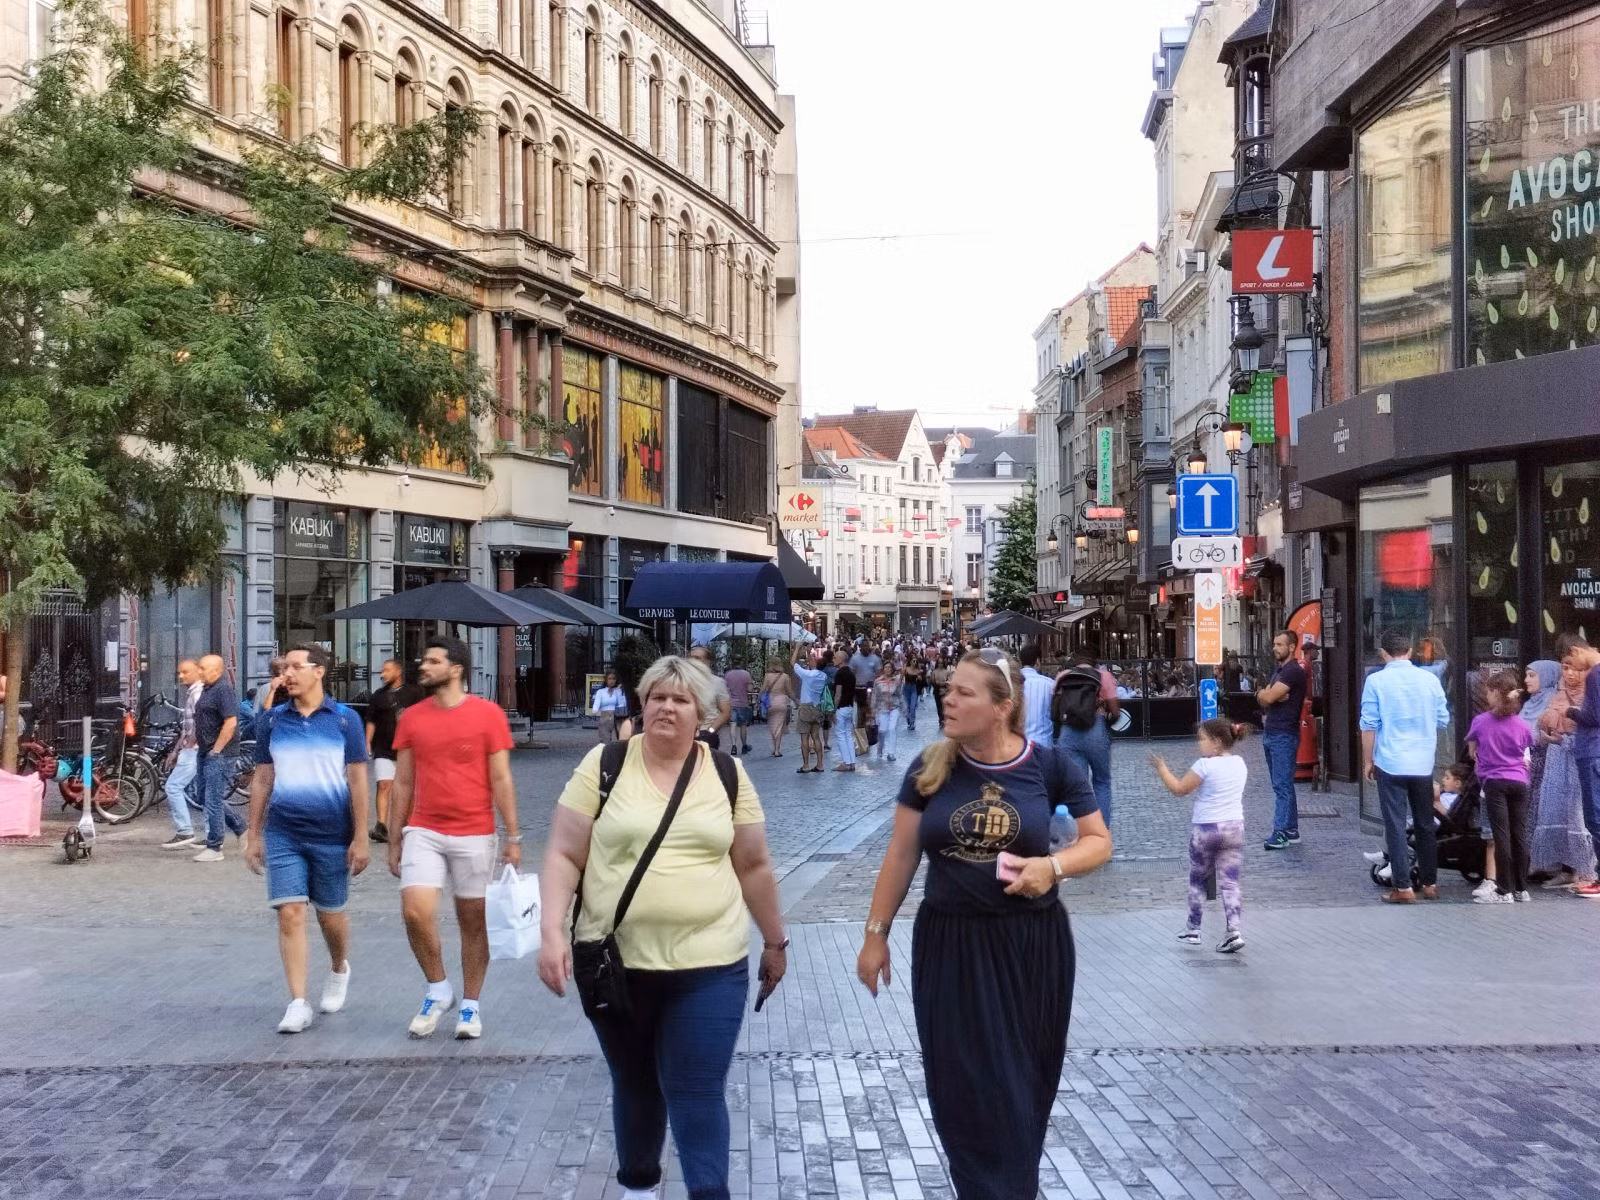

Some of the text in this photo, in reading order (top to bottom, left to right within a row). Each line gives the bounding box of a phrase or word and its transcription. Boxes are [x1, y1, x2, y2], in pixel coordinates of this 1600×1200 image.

[1507, 150, 1600, 212] AVOC
[1550, 200, 1600, 243] SHO
[290, 516, 334, 538] KABUKI
[783, 513, 818, 523] market
[409, 525, 445, 545] KABUKI
[1576, 567, 1592, 579] THE
[1574, 598, 1595, 609] SHOW
